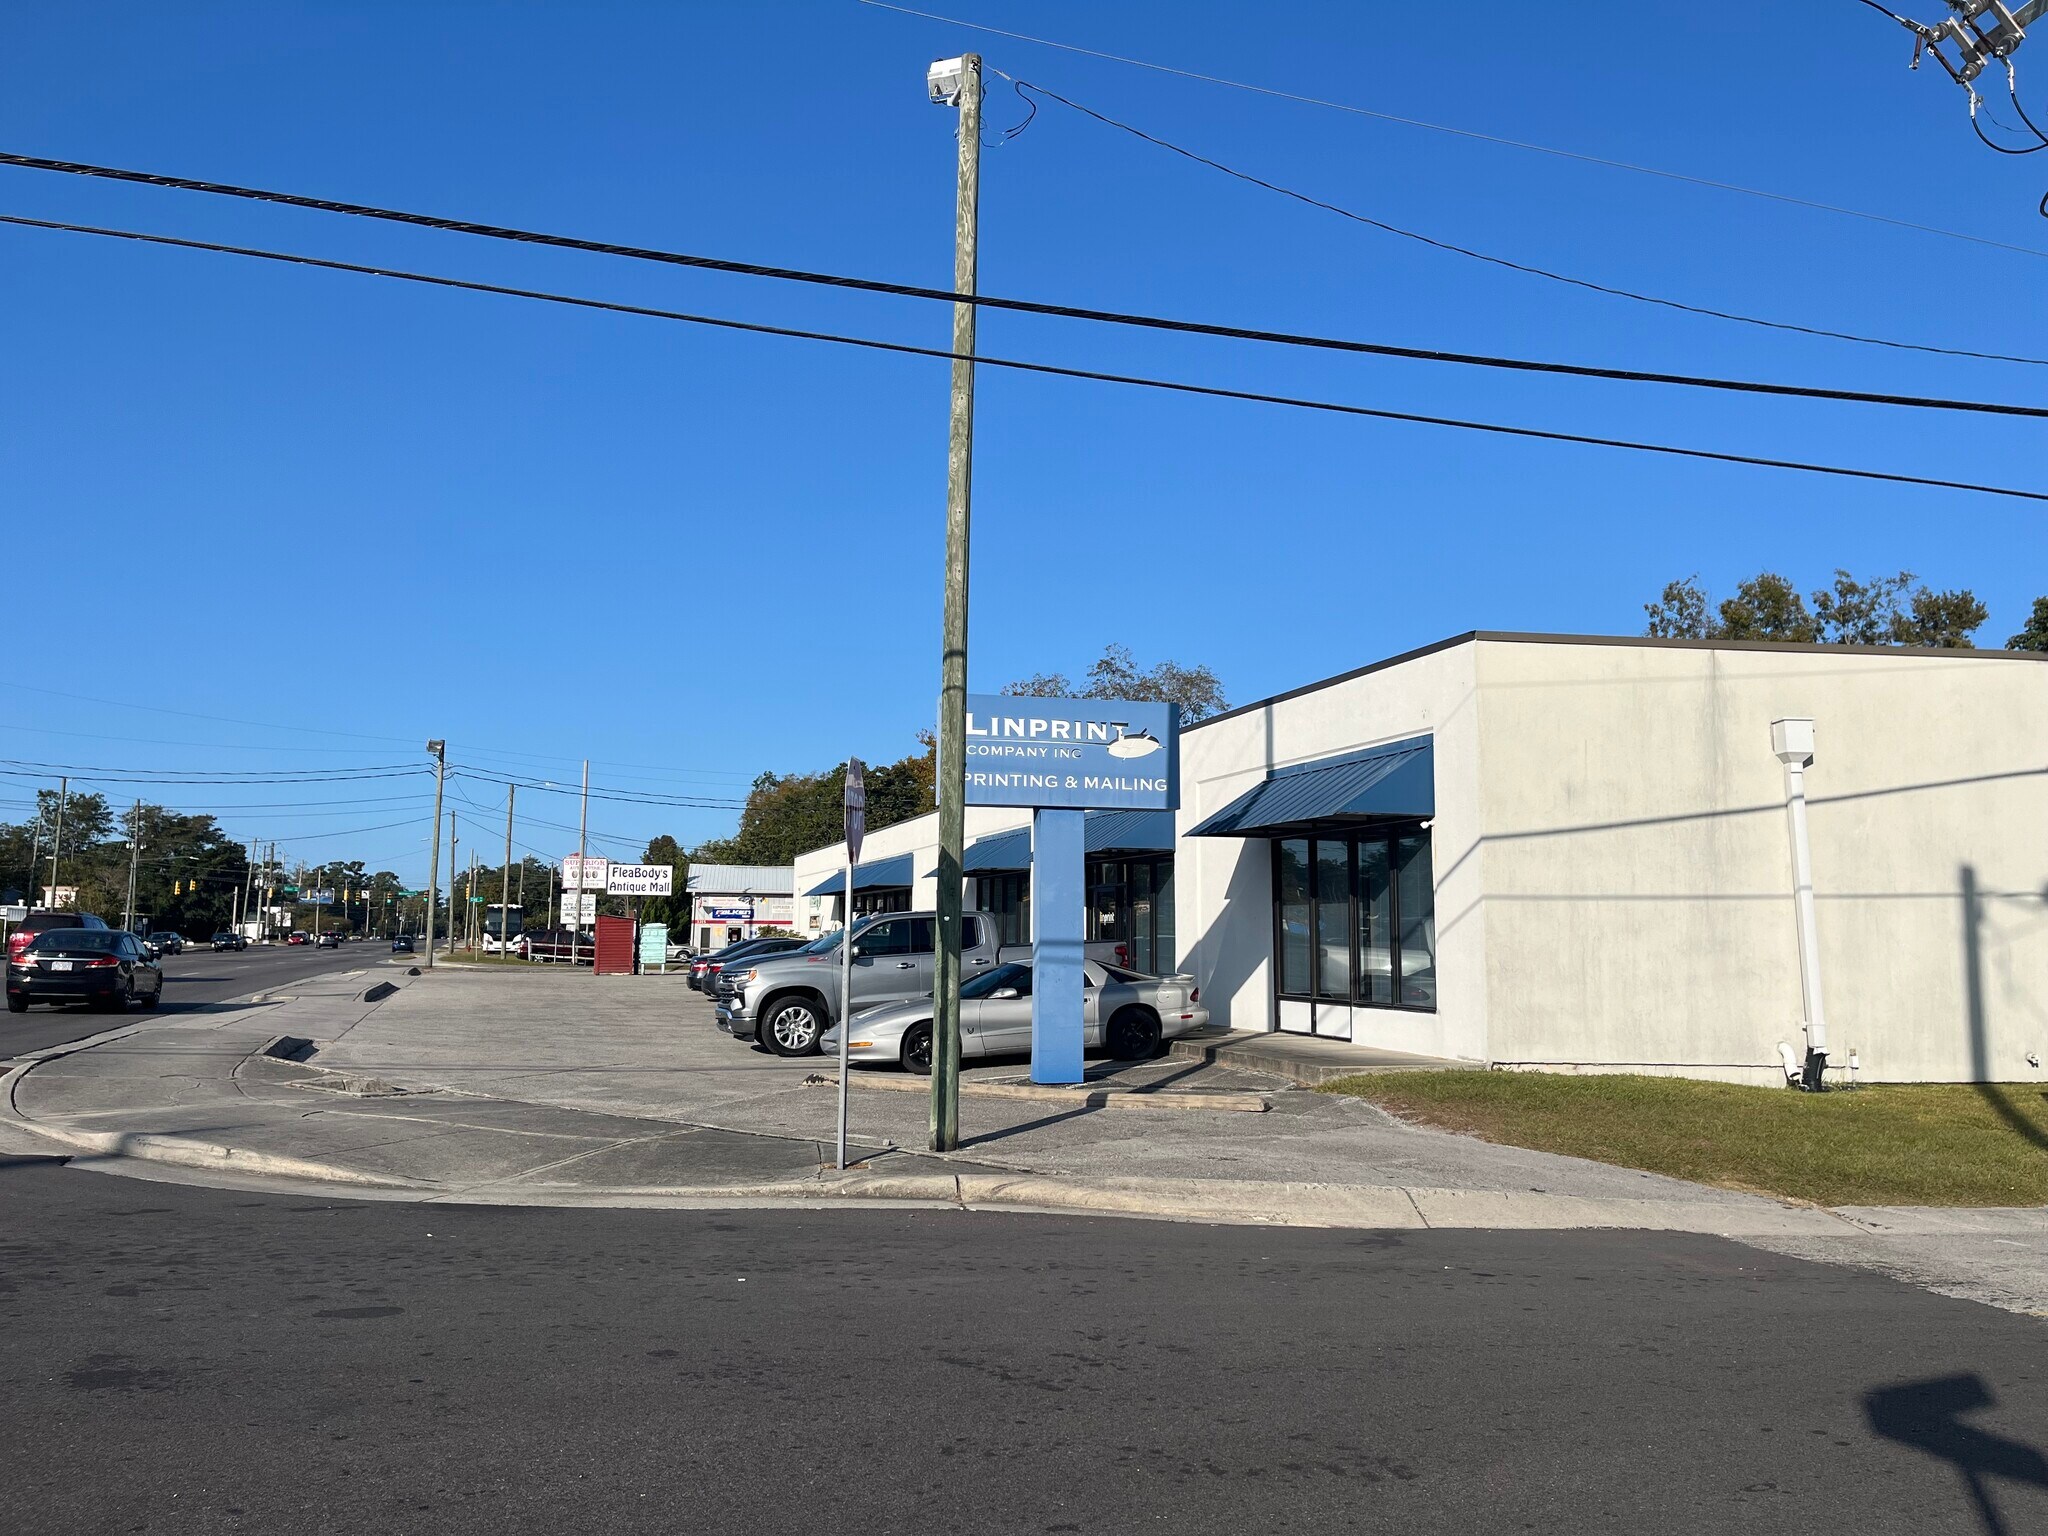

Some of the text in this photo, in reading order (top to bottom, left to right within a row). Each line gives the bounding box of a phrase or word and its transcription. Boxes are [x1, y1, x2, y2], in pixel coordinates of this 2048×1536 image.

[966, 712, 1129, 741] LINPRINT
[966, 745, 1082, 759] COMPANY INC
[965, 773, 1168, 791] PRINTING & MAILING
[612, 867, 668, 880] FleaBody's
[609, 881, 670, 893] Antique Mall
